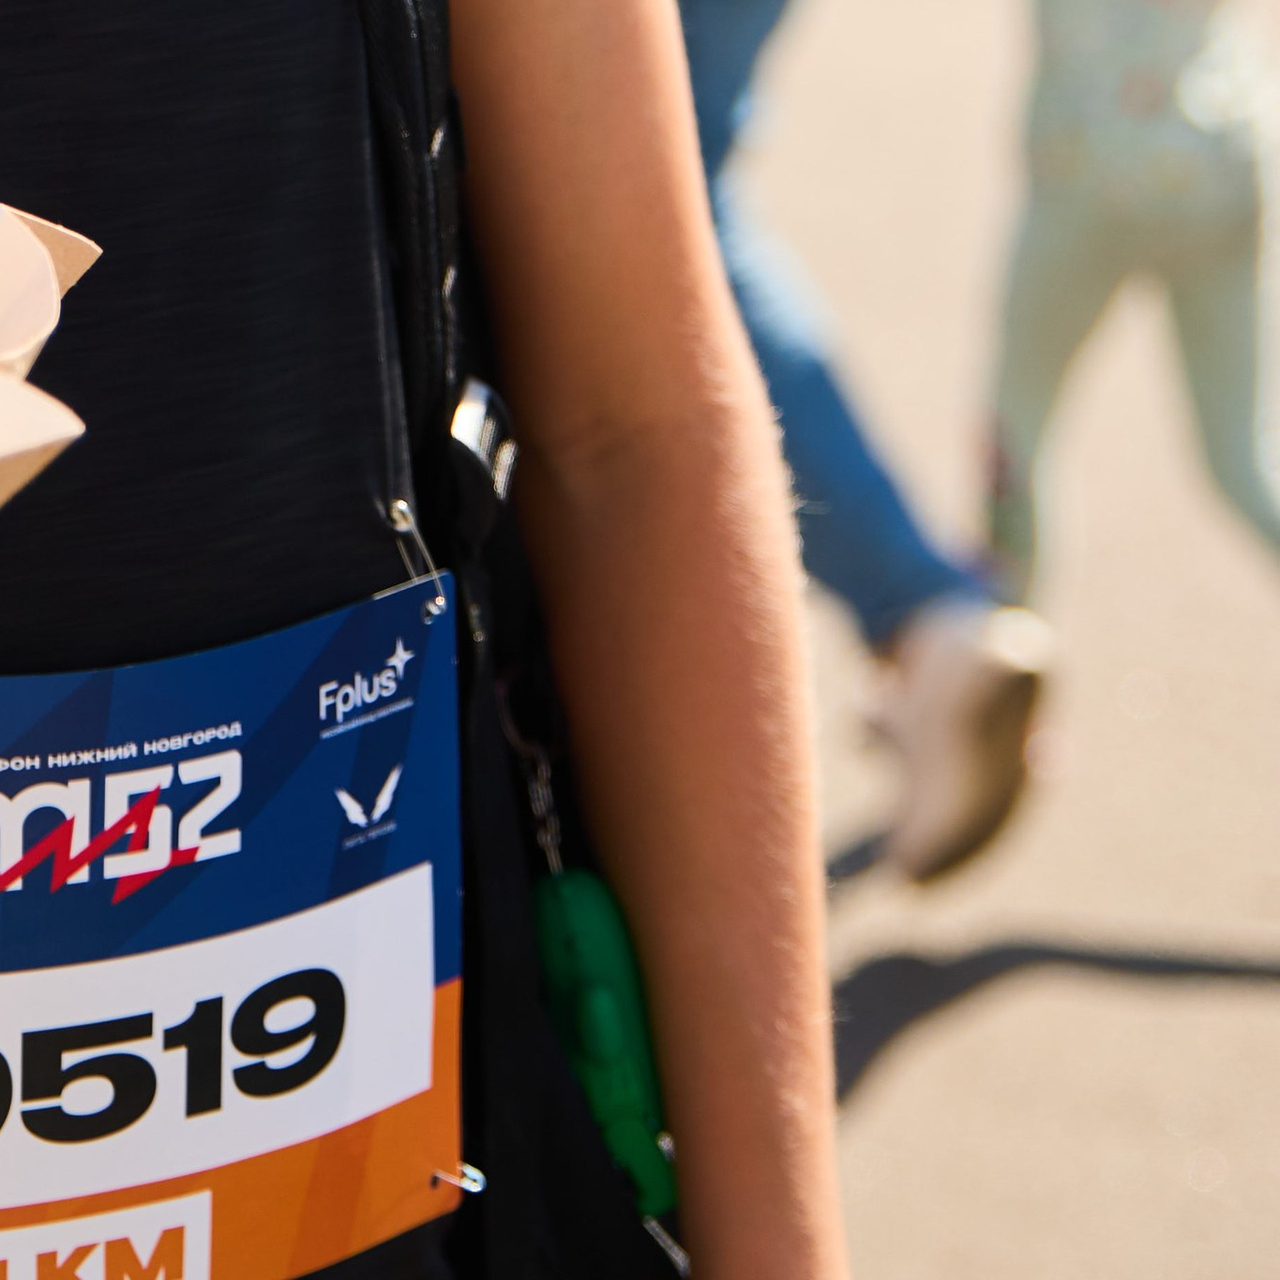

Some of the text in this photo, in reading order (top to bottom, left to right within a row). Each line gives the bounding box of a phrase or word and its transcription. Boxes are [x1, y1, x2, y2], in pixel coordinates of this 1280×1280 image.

[319, 668, 398, 723] Fplus
[48, 741, 138, 768] НИЖНИЙ
[144, 720, 243, 755] НОВГОРОД
